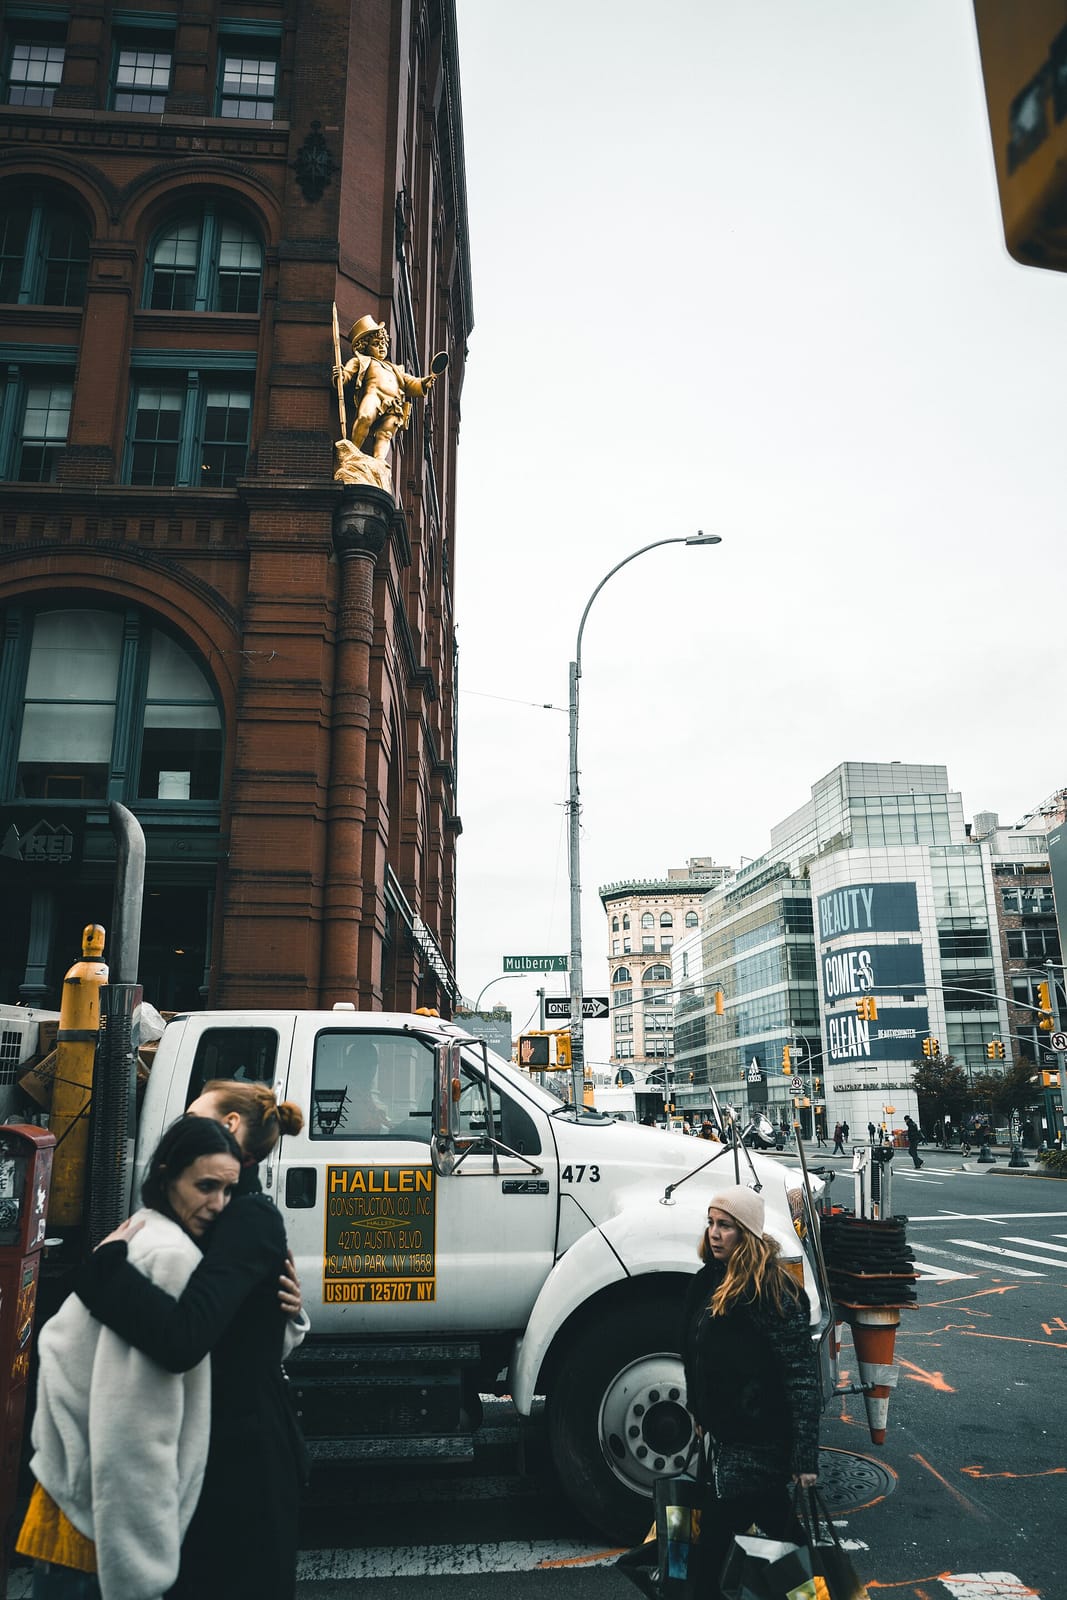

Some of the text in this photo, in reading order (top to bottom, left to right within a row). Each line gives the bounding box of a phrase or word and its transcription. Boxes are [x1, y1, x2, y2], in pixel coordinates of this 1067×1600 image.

[26, 835, 73, 853] REI
[821, 888, 873, 937] BEAUTY
[506, 957, 567, 971] Mulberry St
[825, 951, 874, 998] COMES
[550, 1004, 569, 1013] ONE
[829, 1015, 871, 1060] CLEAN
[331, 1170, 432, 1193] HALLEN
[562, 1165, 600, 1183] 473
[330, 1197, 395, 1216] CONSTRUCTION
[338, 1231, 361, 1250] 4270
[364, 1231, 396, 1249] AUSTIN
[328, 1255, 361, 1274] ISLAND
[393, 1254, 407, 1273] NY
[409, 1253, 432, 1273] 11558
[326, 1283, 433, 1301] USDOT 125707 NY
